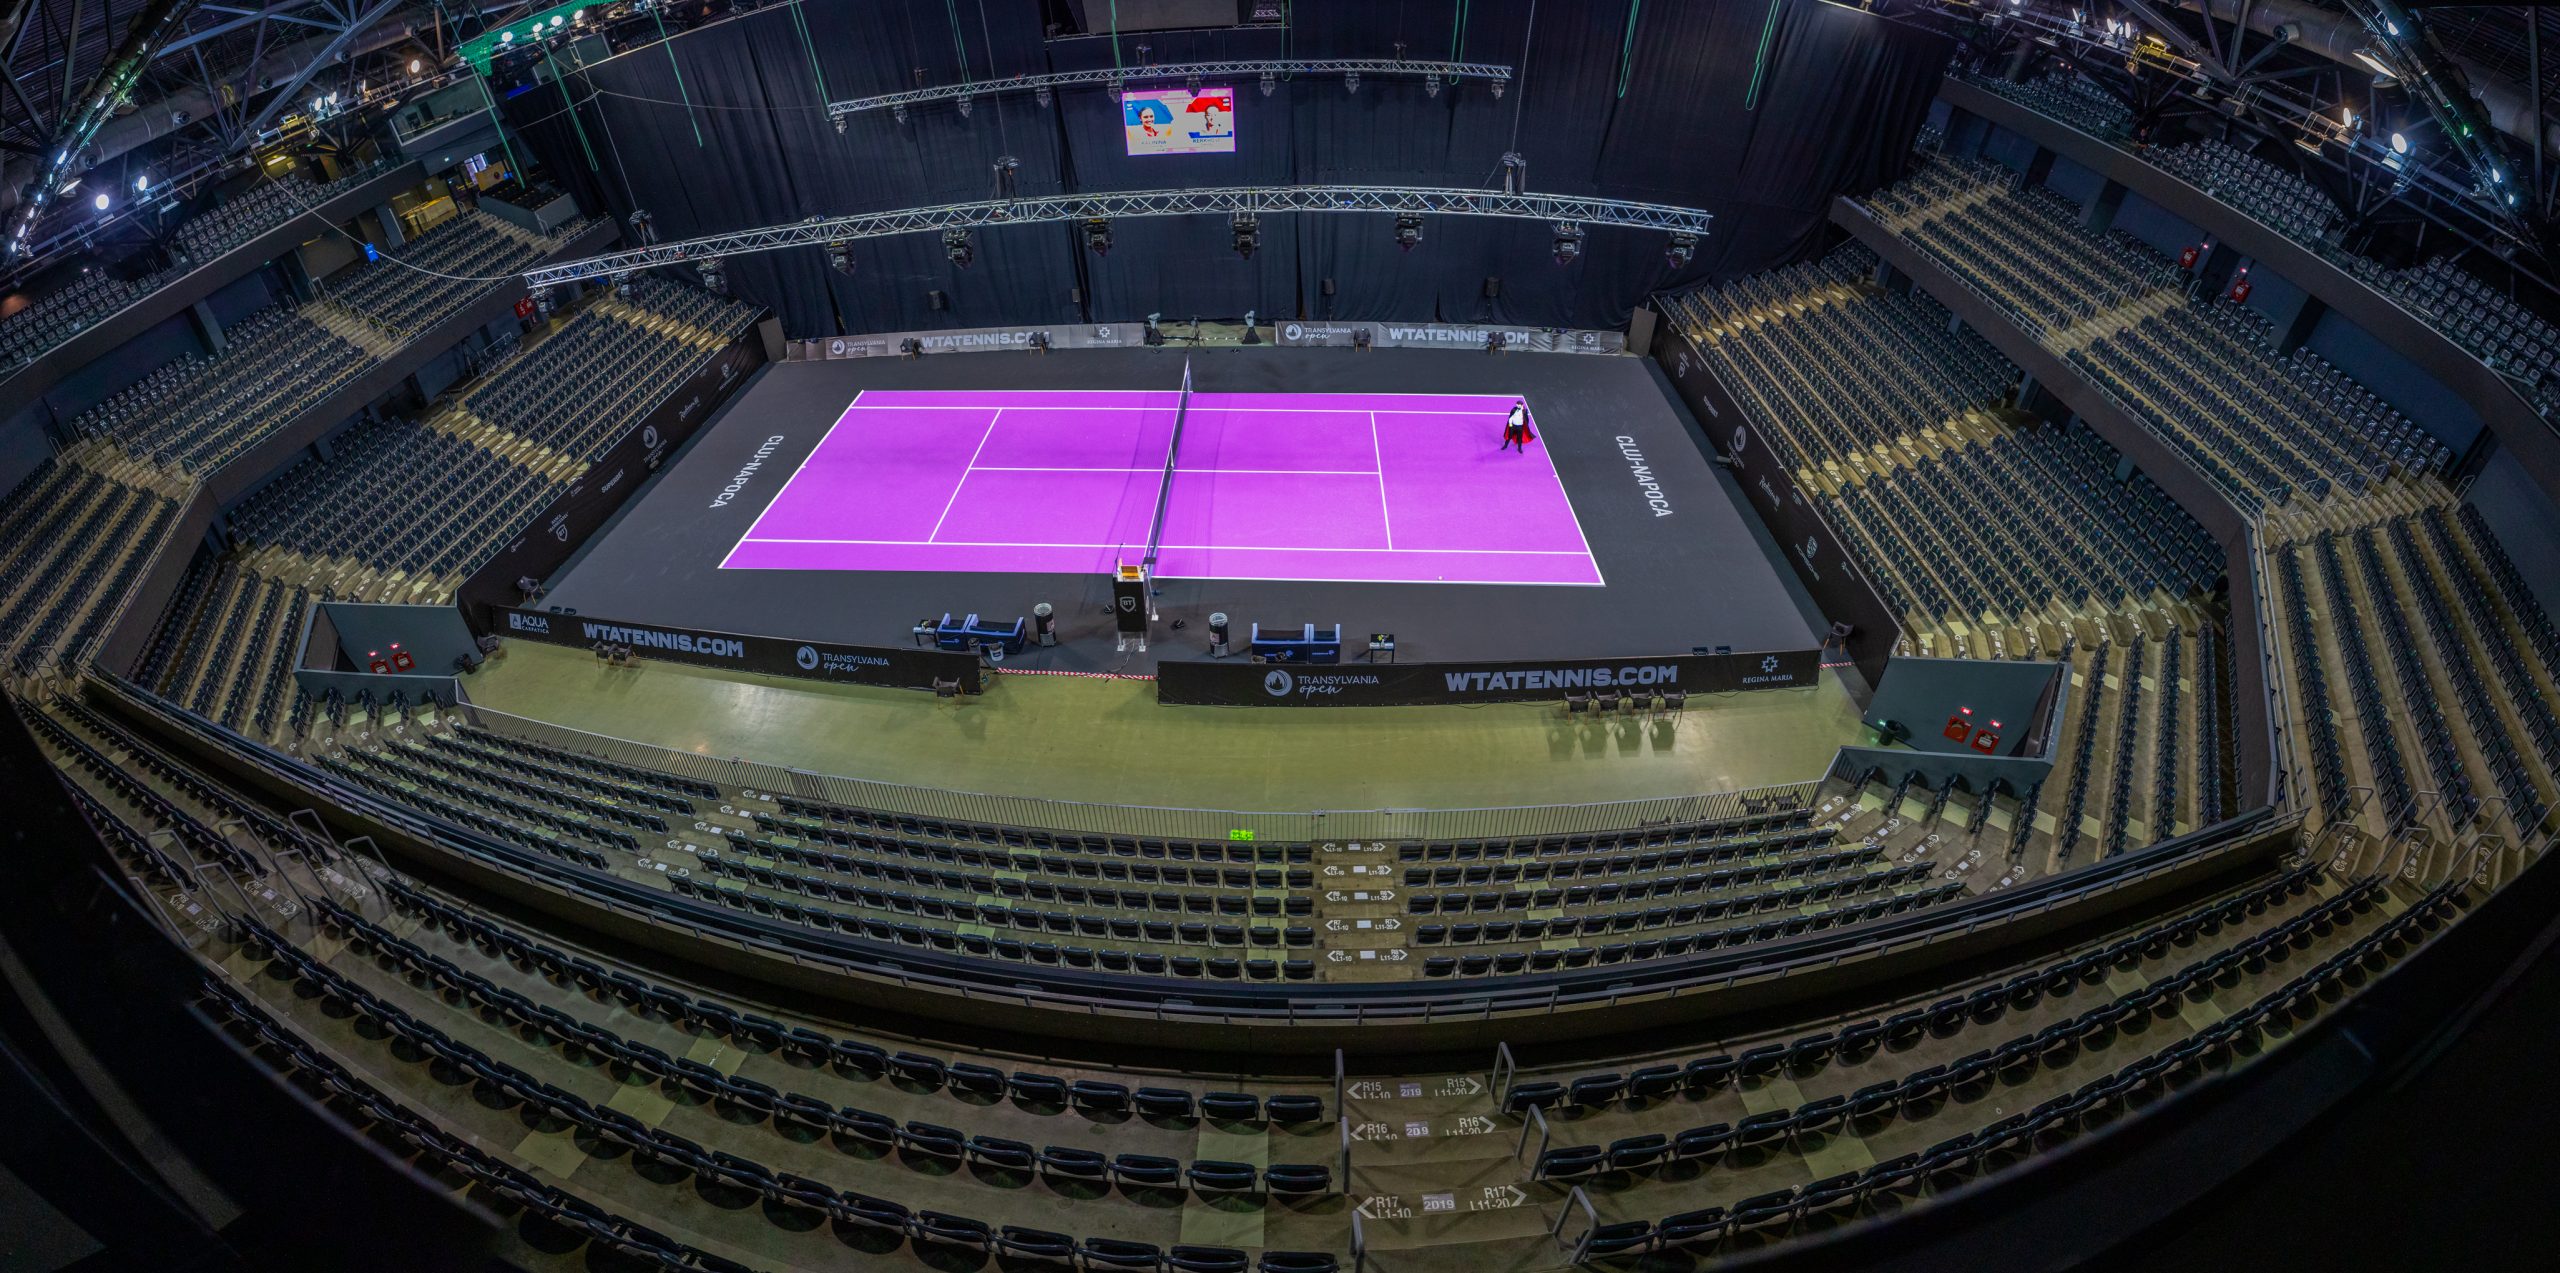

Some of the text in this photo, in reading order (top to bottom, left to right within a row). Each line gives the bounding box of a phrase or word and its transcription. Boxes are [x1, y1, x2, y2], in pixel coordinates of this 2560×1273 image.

[921, 331, 1050, 348] WTATENNIS.C
[1305, 333, 1331, 343] open
[1389, 327, 1529, 344] WTATENNISOM
[709, 435, 784, 508] CLUJ-NAPOCA
[1616, 435, 1673, 517] CLUJ-NAPOCA
[522, 615, 549, 628] AQUA
[583, 622, 744, 658] WTATENNIS.COM
[821, 652, 890, 666] TRANSYLVANIA
[824, 662, 859, 674] open
[1297, 675, 1379, 684] TRANSYLVANIA
[1445, 665, 1678, 692] WTATENNIS.COM
[1742, 673, 1793, 684] REGINA MARIA
[1300, 685, 1343, 700] open
[1362, 1081, 1382, 1092] R15
[1447, 1077, 1466, 1088] R15
[1367, 1123, 1387, 1134] R16
[1459, 1117, 1479, 1128] R16
[1484, 1186, 1506, 1199] R17
[1376, 1196, 1399, 1208] R17
[1470, 1198, 1510, 1211] L11-20
[1377, 1208, 1411, 1218] L1-10
